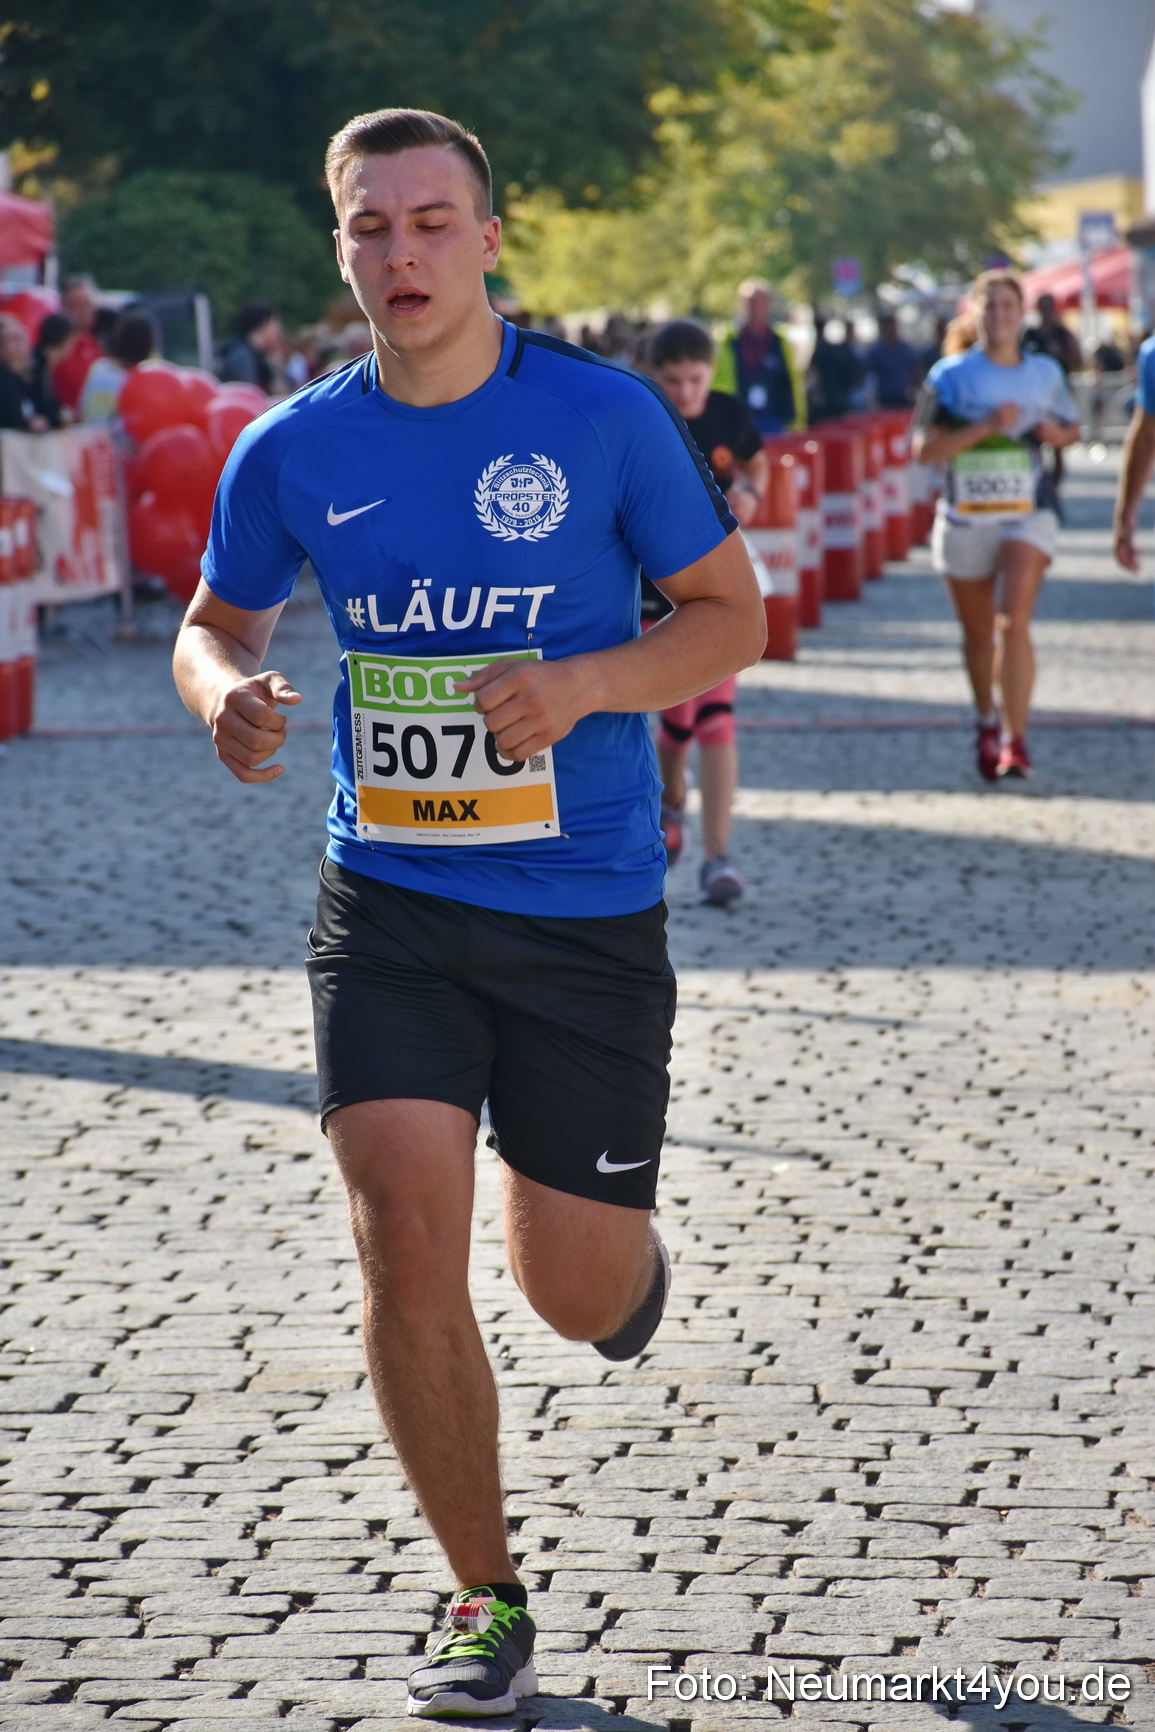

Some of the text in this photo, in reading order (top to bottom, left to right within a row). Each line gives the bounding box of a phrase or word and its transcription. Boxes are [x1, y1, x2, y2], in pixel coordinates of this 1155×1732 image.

[493, 466, 551, 489] Blitzschutztechnik
[512, 502, 530, 513] 40
[515, 505, 541, 517] Innovation
[501, 514, 518, 526] 1979
[524, 514, 542, 526] 2019
[346, 578, 556, 633] #LÄUFT
[360, 662, 489, 706] BOC
[412, 798, 481, 822] MAX
